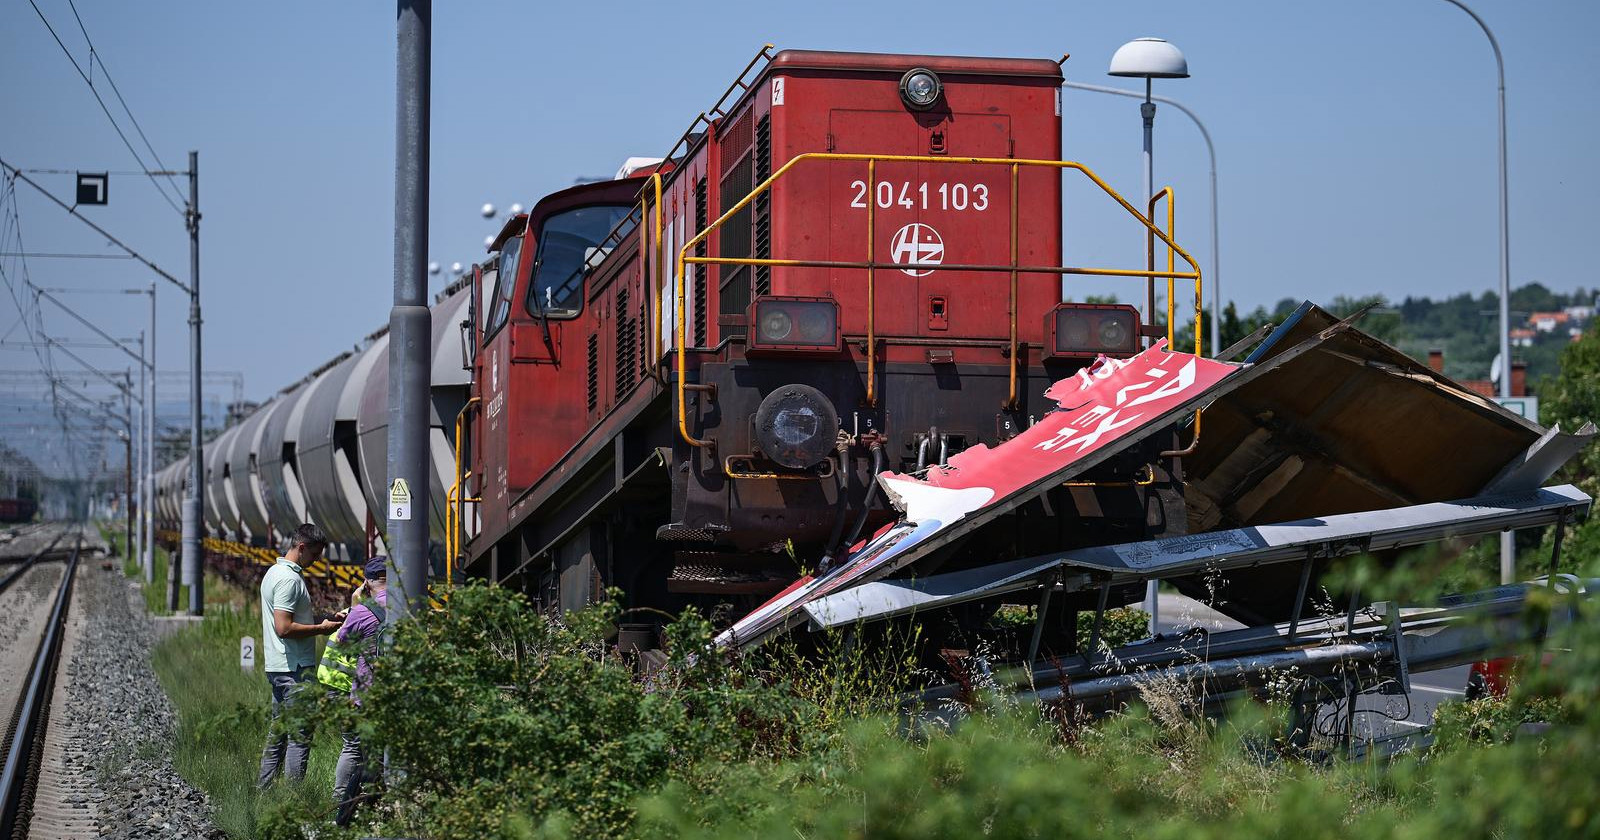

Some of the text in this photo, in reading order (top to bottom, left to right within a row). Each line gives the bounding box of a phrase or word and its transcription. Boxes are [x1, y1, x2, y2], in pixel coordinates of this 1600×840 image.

[867, 418, 872, 427] 5
[1005, 421, 1010, 430] 5
[396, 507, 403, 517] 6
[243, 645, 252, 659] 2
